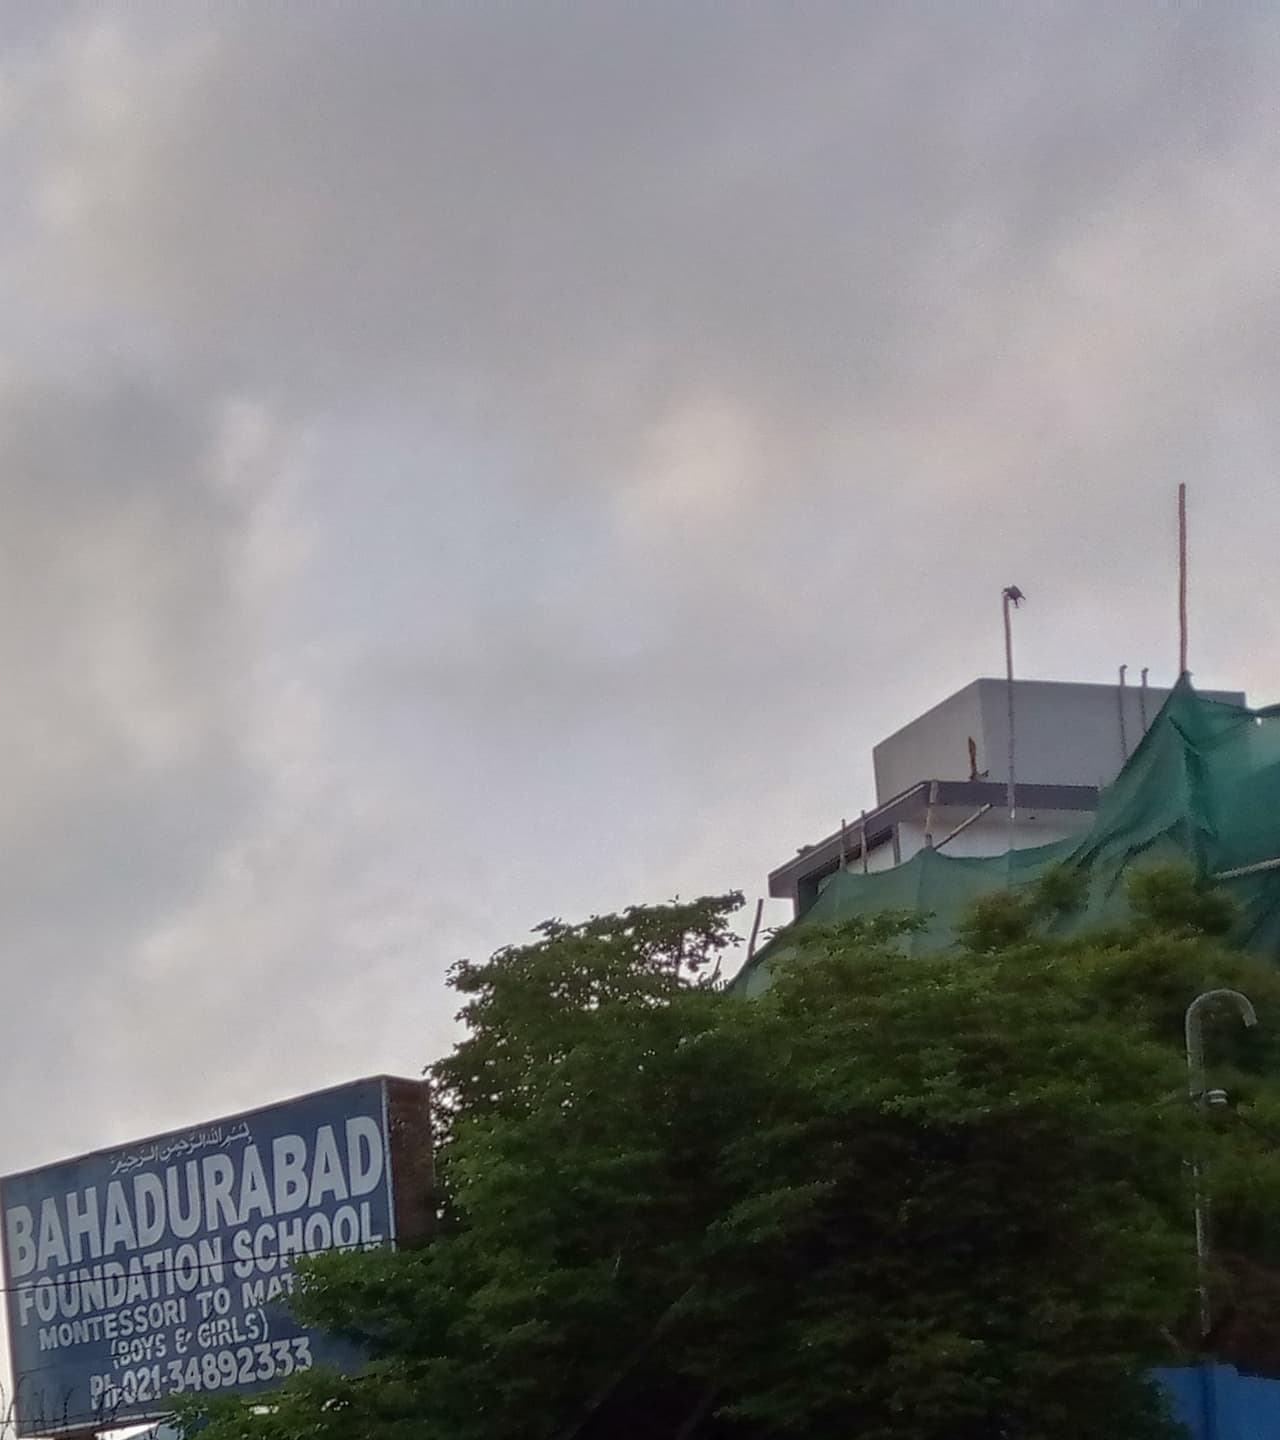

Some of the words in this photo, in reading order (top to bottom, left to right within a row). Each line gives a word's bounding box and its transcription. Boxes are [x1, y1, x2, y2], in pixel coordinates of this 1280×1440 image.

[6, 1115, 383, 1278] BAHADURABAD
[16, 1236, 224, 1328] FOUNDATION
[233, 1201, 384, 1278] SCHOOL
[39, 1298, 186, 1351] MONTESSORI
[195, 1287, 231, 1319] TO
[111, 1333, 167, 1370] (BOYS
[175, 1327, 193, 1354] &
[197, 1308, 269, 1349] GIRLS)
